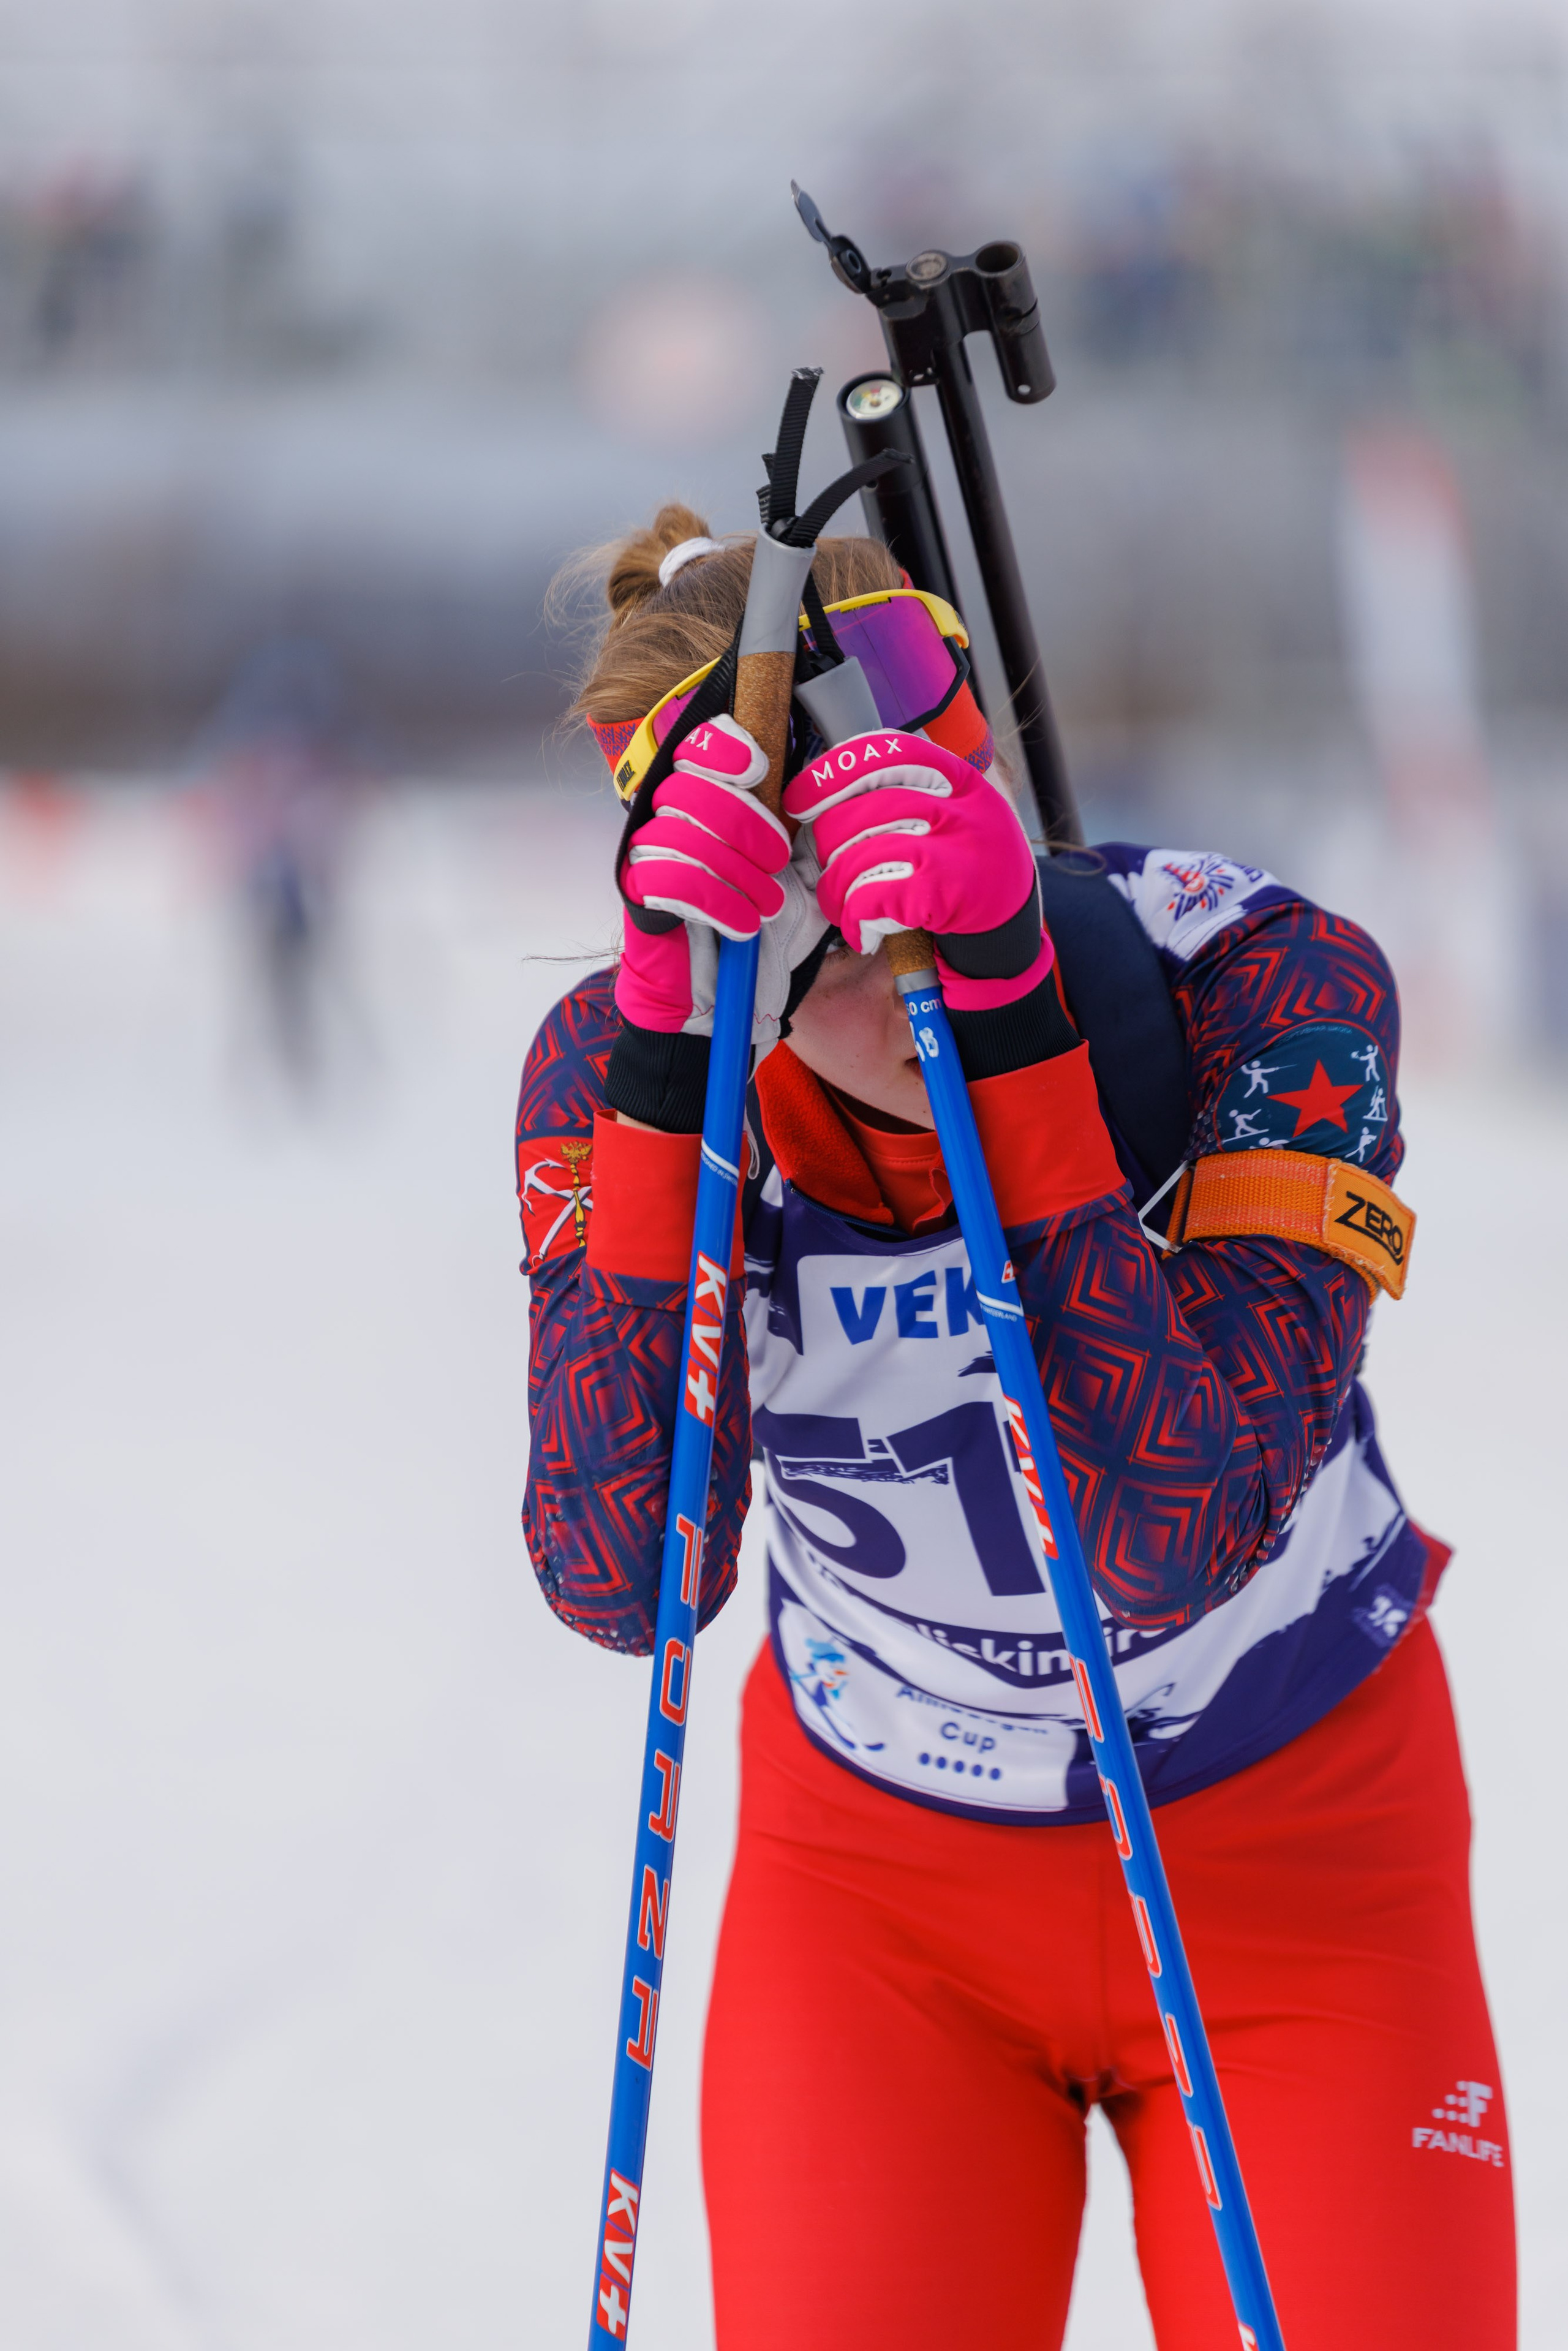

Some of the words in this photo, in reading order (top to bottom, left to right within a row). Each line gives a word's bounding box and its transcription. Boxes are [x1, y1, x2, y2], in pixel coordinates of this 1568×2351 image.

[811, 738, 903, 787] MOAX
[920, 998, 942, 1013] cm
[1334, 1190, 1403, 1266] ZERO
[687, 1255, 727, 1420] KV+
[752, 1401, 1046, 1596] 51
[940, 1722, 997, 1754] Cup
[599, 2172, 639, 2335] KV+
